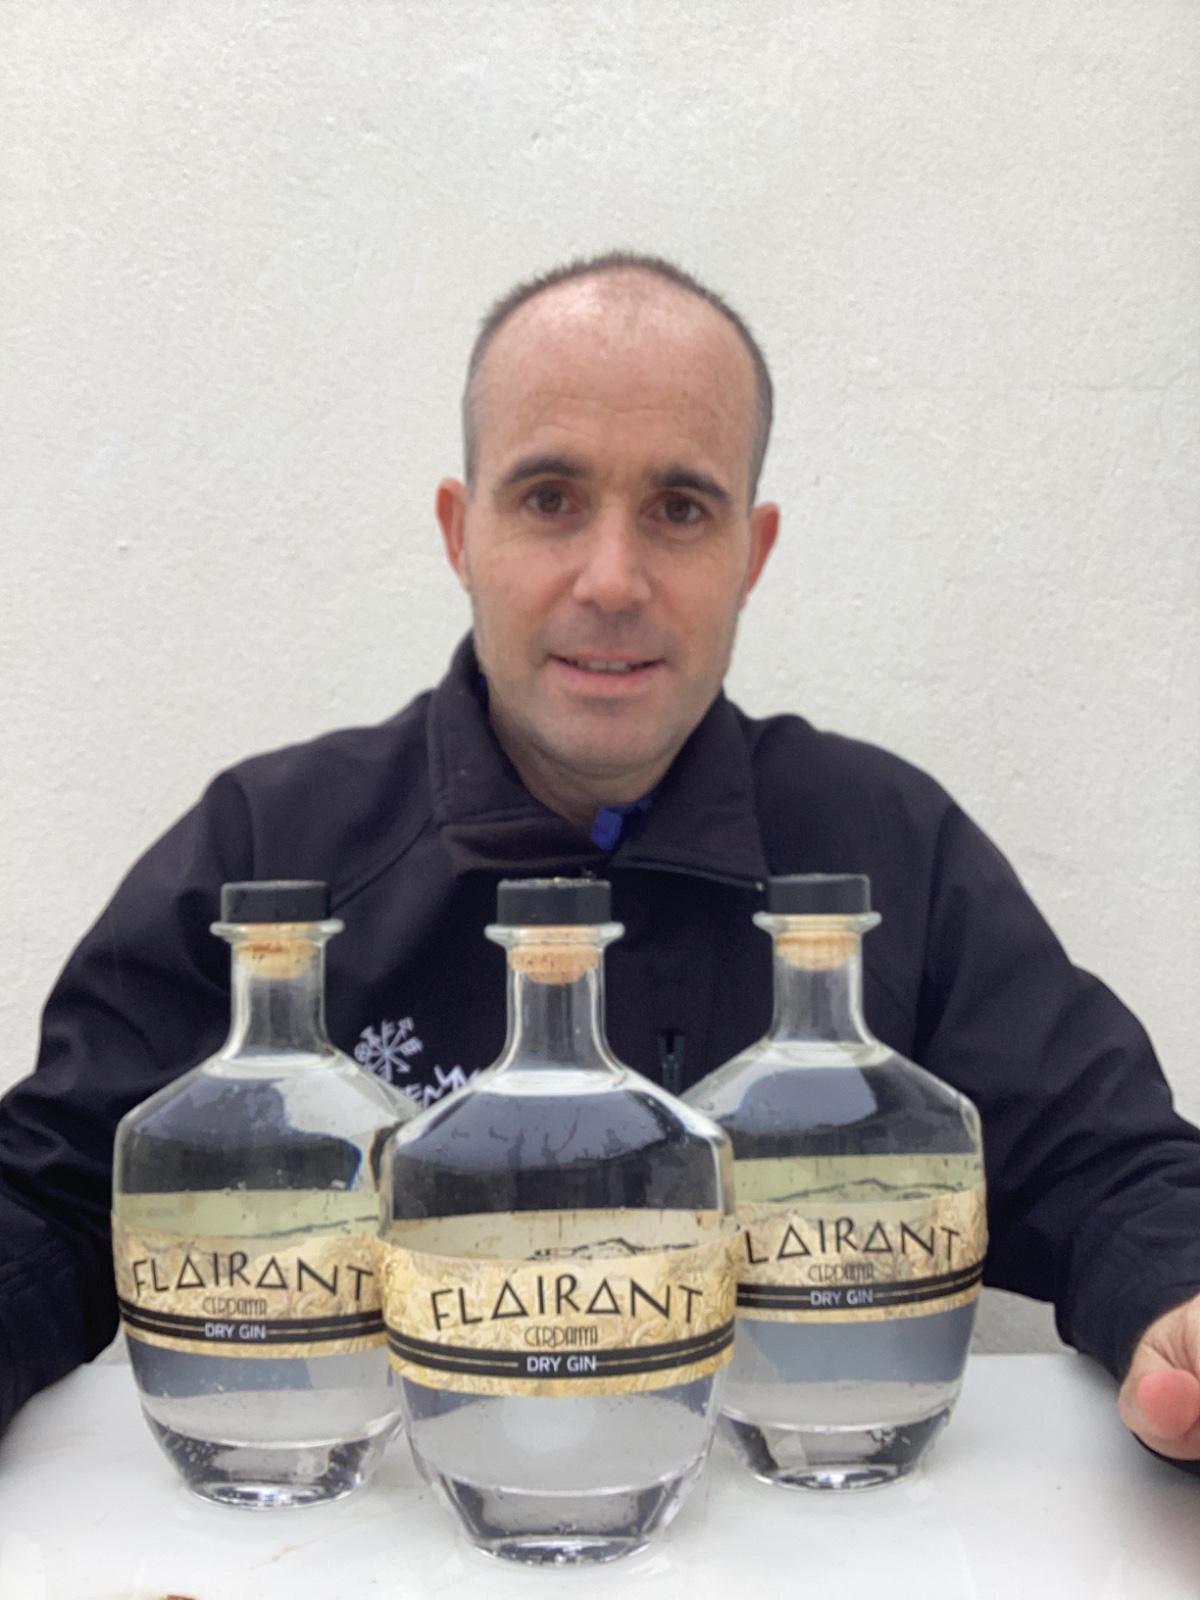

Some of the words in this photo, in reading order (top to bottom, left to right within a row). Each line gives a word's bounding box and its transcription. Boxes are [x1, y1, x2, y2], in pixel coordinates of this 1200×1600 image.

[737, 1217, 960, 1265] LAIRANT
[131, 1250, 374, 1300] FLAIRANT
[430, 1274, 703, 1331] FLAIRANT
[810, 1289, 841, 1306] DRY
[846, 1288, 874, 1305] GIN
[204, 1322, 235, 1339] DRY
[239, 1323, 267, 1340] GIN
[526, 1354, 562, 1373] DRY
[566, 1354, 597, 1373] GIN
